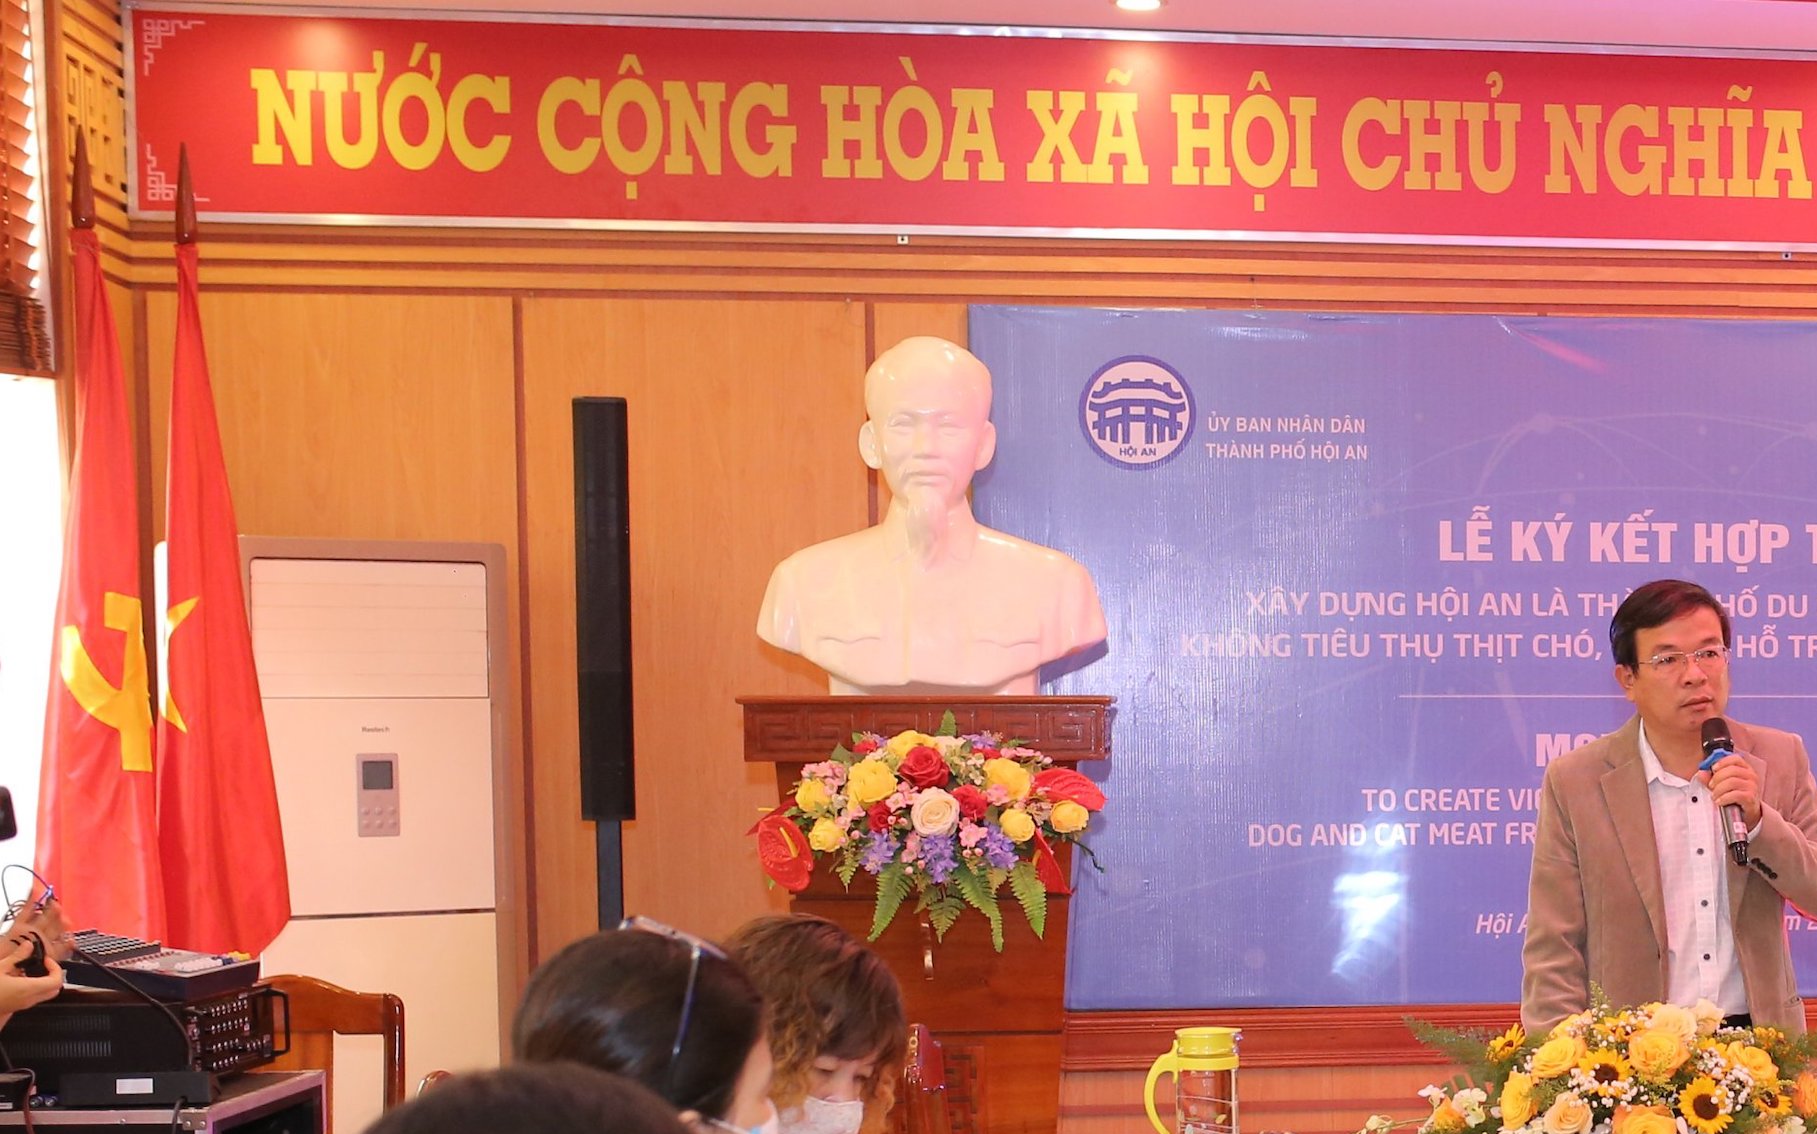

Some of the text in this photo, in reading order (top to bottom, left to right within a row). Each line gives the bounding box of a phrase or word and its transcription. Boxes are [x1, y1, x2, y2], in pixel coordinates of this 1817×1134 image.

[250, 42, 513, 173] NƯỚC
[536, 53, 798, 200] CỘNG
[820, 56, 1005, 182] HÒA
[1026, 67, 1149, 185] XÃ
[1170, 71, 1318, 211] HỘI
[1341, 71, 1521, 195] CHỦ
[1543, 84, 1813, 199] NGHĨA
[1207, 411, 1366, 434] ỦY BAN NHÂN DÂN
[1140, 447, 1157, 457] AN
[1205, 437, 1368, 463] THÀNH PHỐ HỘI AN
[1438, 505, 1494, 562] LỄ
[1511, 512, 1573, 563] KÝ
[1589, 508, 1678, 564] KẾT
[1694, 518, 1790, 573] HỢP
[1246, 586, 1310, 617] XÂY
[1320, 591, 1406, 624] DỰNG
[1416, 586, 1469, 622] HỘI
[1479, 592, 1523, 617] AN
[1532, 587, 1569, 617] LÀ
[1717, 585, 1760, 618] HỐ
[1768, 594, 1810, 619] DU
[1180, 628, 1292, 659] KHÔNG
[1302, 627, 1371, 658] TIÊU
[1380, 633, 1444, 664] THỤ
[1454, 633, 1523, 664] THỊT
[1532, 628, 1603, 661] CHÓ,
[1737, 624, 1779, 659] HỖ
[1361, 788, 1397, 812] TO
[1404, 788, 1501, 812] CREATE
[1248, 823, 1302, 848] DOG
[1310, 823, 1367, 847] AND
[1374, 822, 1421, 847] CAT
[1428, 822, 1498, 846] MEAT
[1505, 822, 1537, 845] FR
[1475, 912, 1514, 940] Hội
